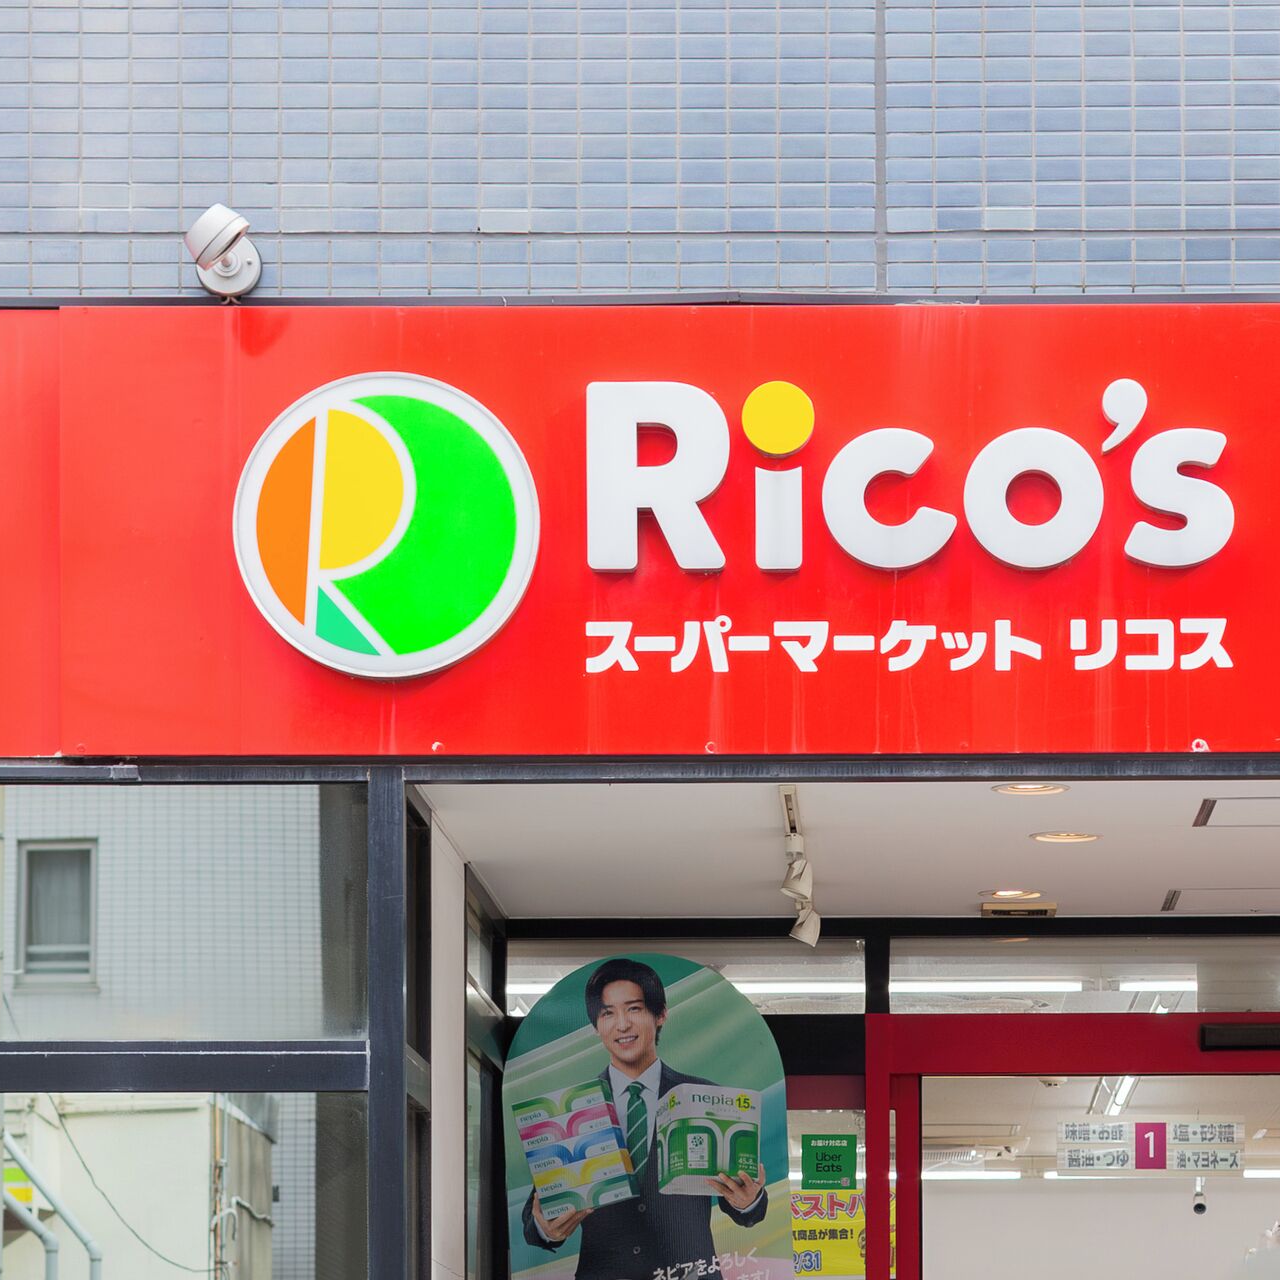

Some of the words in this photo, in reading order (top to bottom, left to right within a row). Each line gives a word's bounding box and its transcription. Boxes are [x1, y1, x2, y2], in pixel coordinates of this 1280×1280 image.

[586, 379, 1235, 572] Rico's
[585, 616, 1040, 673] スーパーマーケット
[1070, 617, 1235, 671] リコス
[692, 1094, 734, 1107] nepia
[1144, 1131, 1155, 1158] 1
[815, 1151, 842, 1162] Uber
[815, 1162, 842, 1173] Eats
